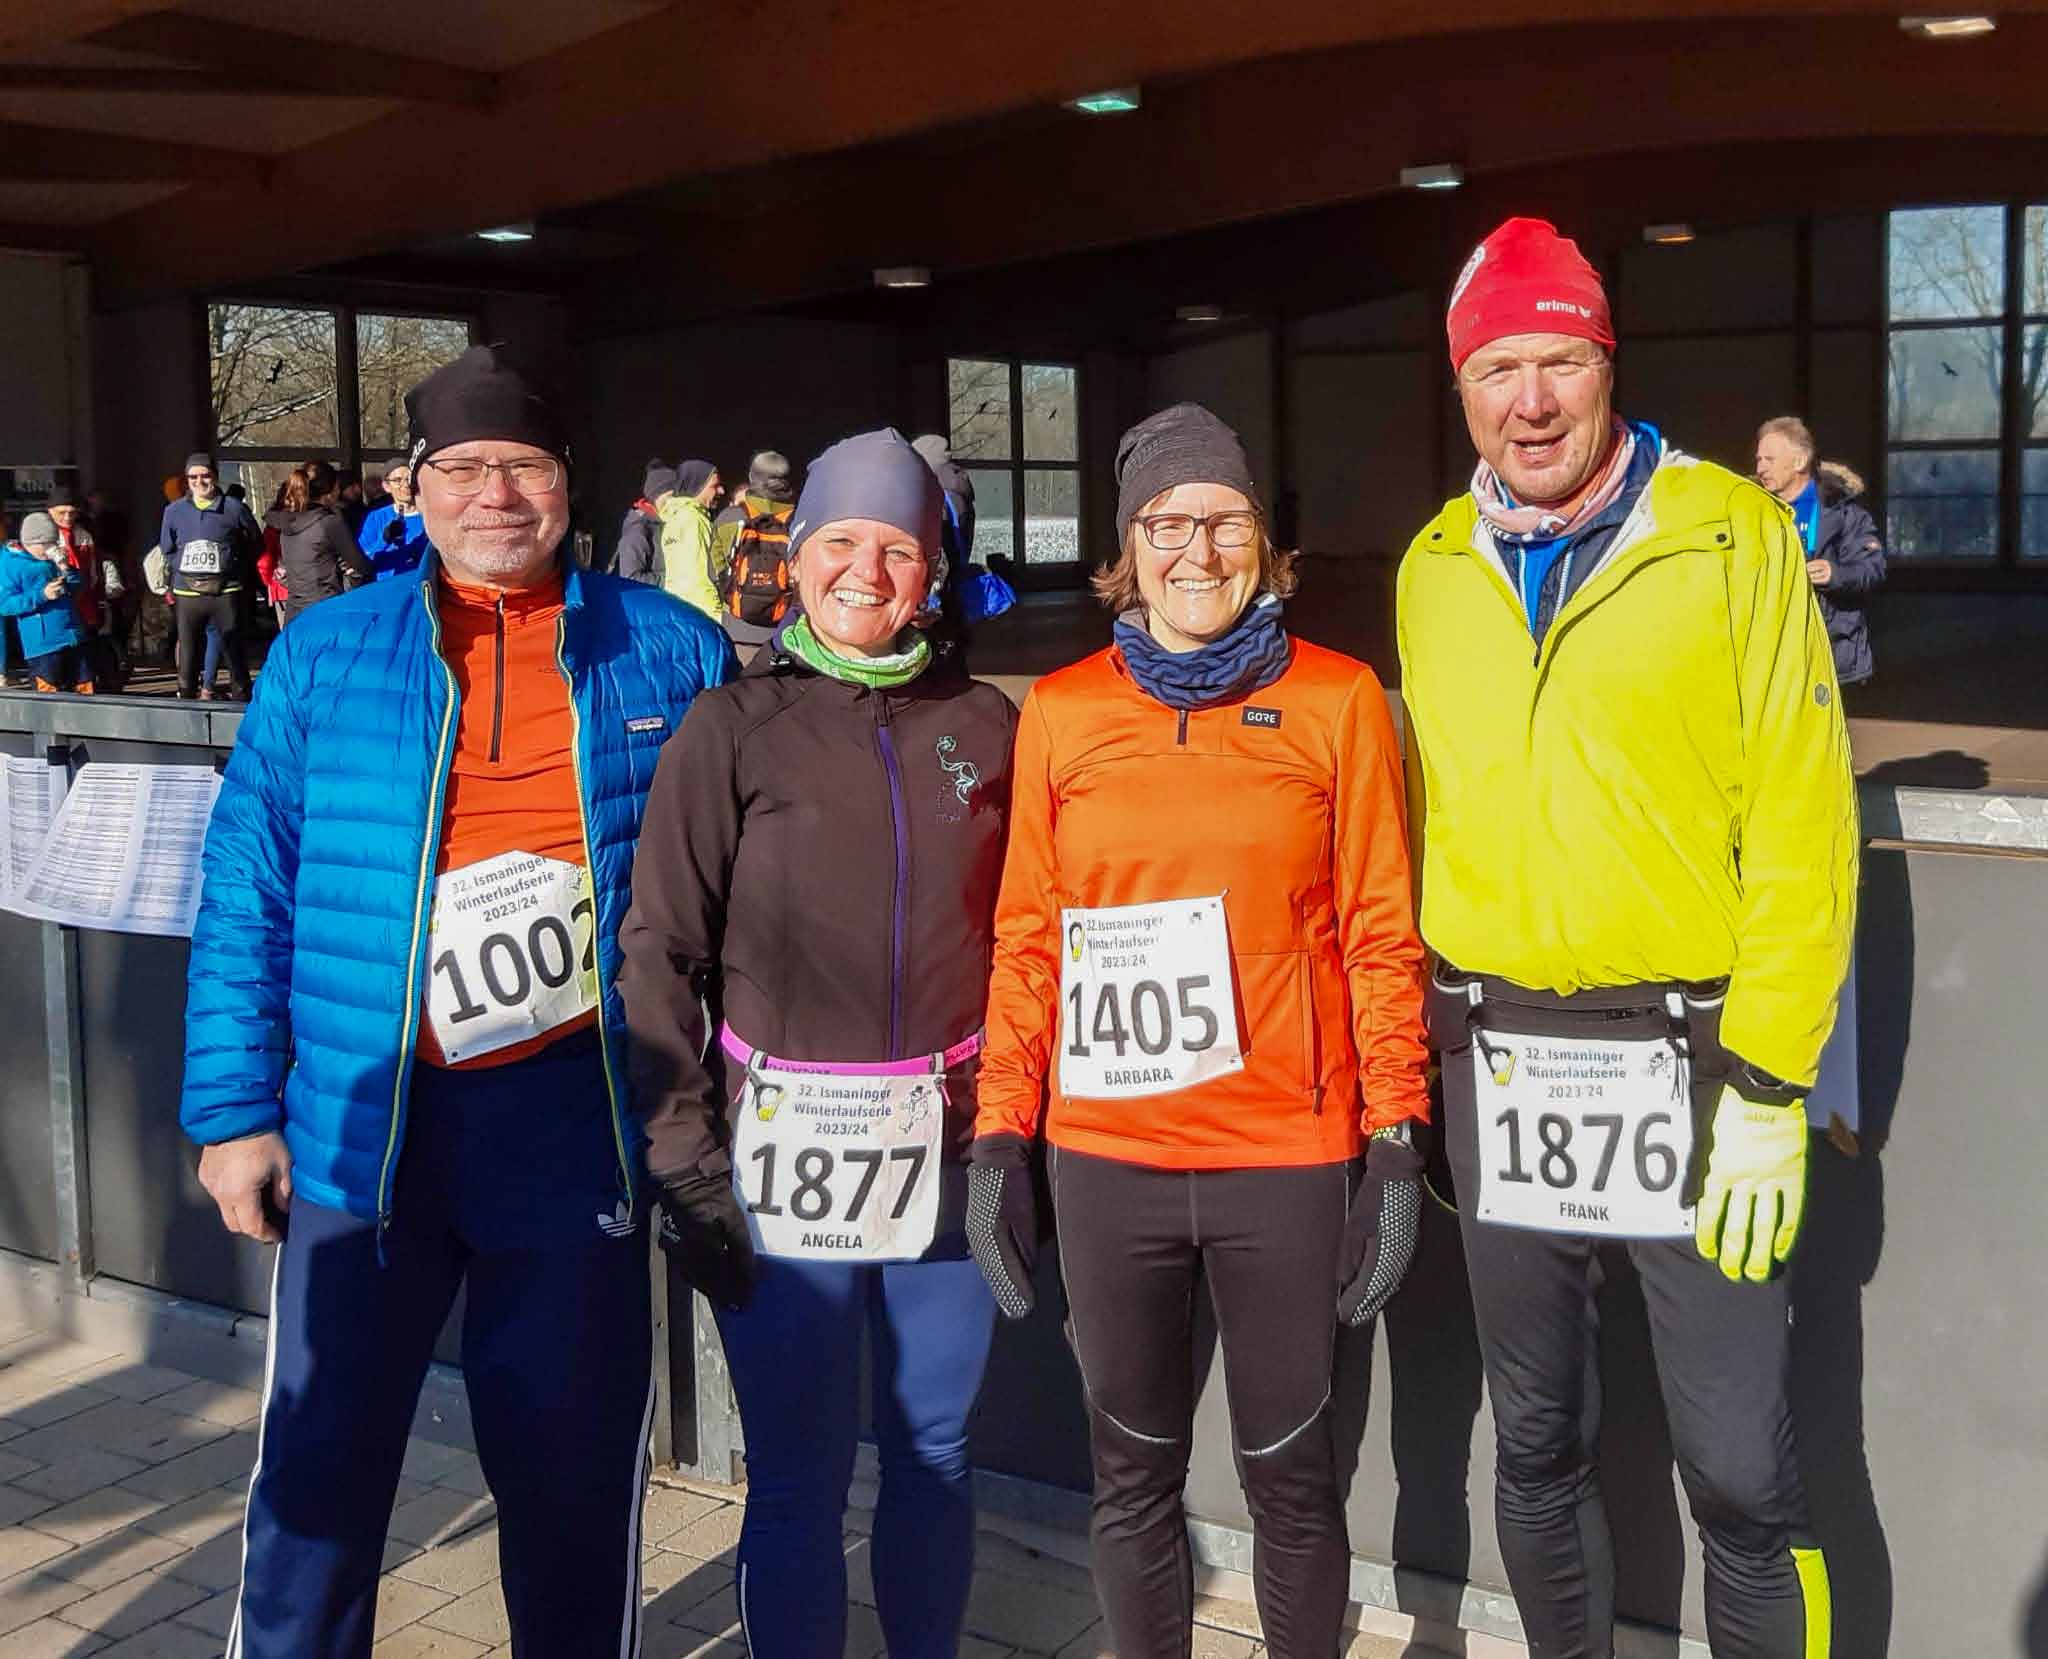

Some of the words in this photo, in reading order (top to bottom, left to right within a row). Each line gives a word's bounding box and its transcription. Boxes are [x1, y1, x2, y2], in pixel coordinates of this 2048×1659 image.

[1247, 711, 1277, 724] GORE
[452, 879, 473, 896] 32.
[473, 856, 547, 887] Ismaninger
[454, 870, 556, 913] Winterlaufserie
[483, 893, 539, 923] 2023/24
[1069, 974, 1219, 1057] 1405
[1525, 1046, 1545, 1060] 32.
[1547, 1048, 1625, 1064] Ismaninger
[1104, 1067, 1174, 1086] BARBARA
[1526, 1064, 1627, 1079] Winterlaufserie
[820, 1085, 892, 1102] Ismaninger
[1547, 1084, 1604, 1098] 202324
[794, 1102, 892, 1118] Winterlaufserie
[815, 1122, 869, 1136] 2023/24
[1496, 1107, 1678, 1193] 1876
[747, 1142, 928, 1222] 1877
[1560, 1202, 1609, 1221] FRANK
[801, 1233, 863, 1250] ANGELA
